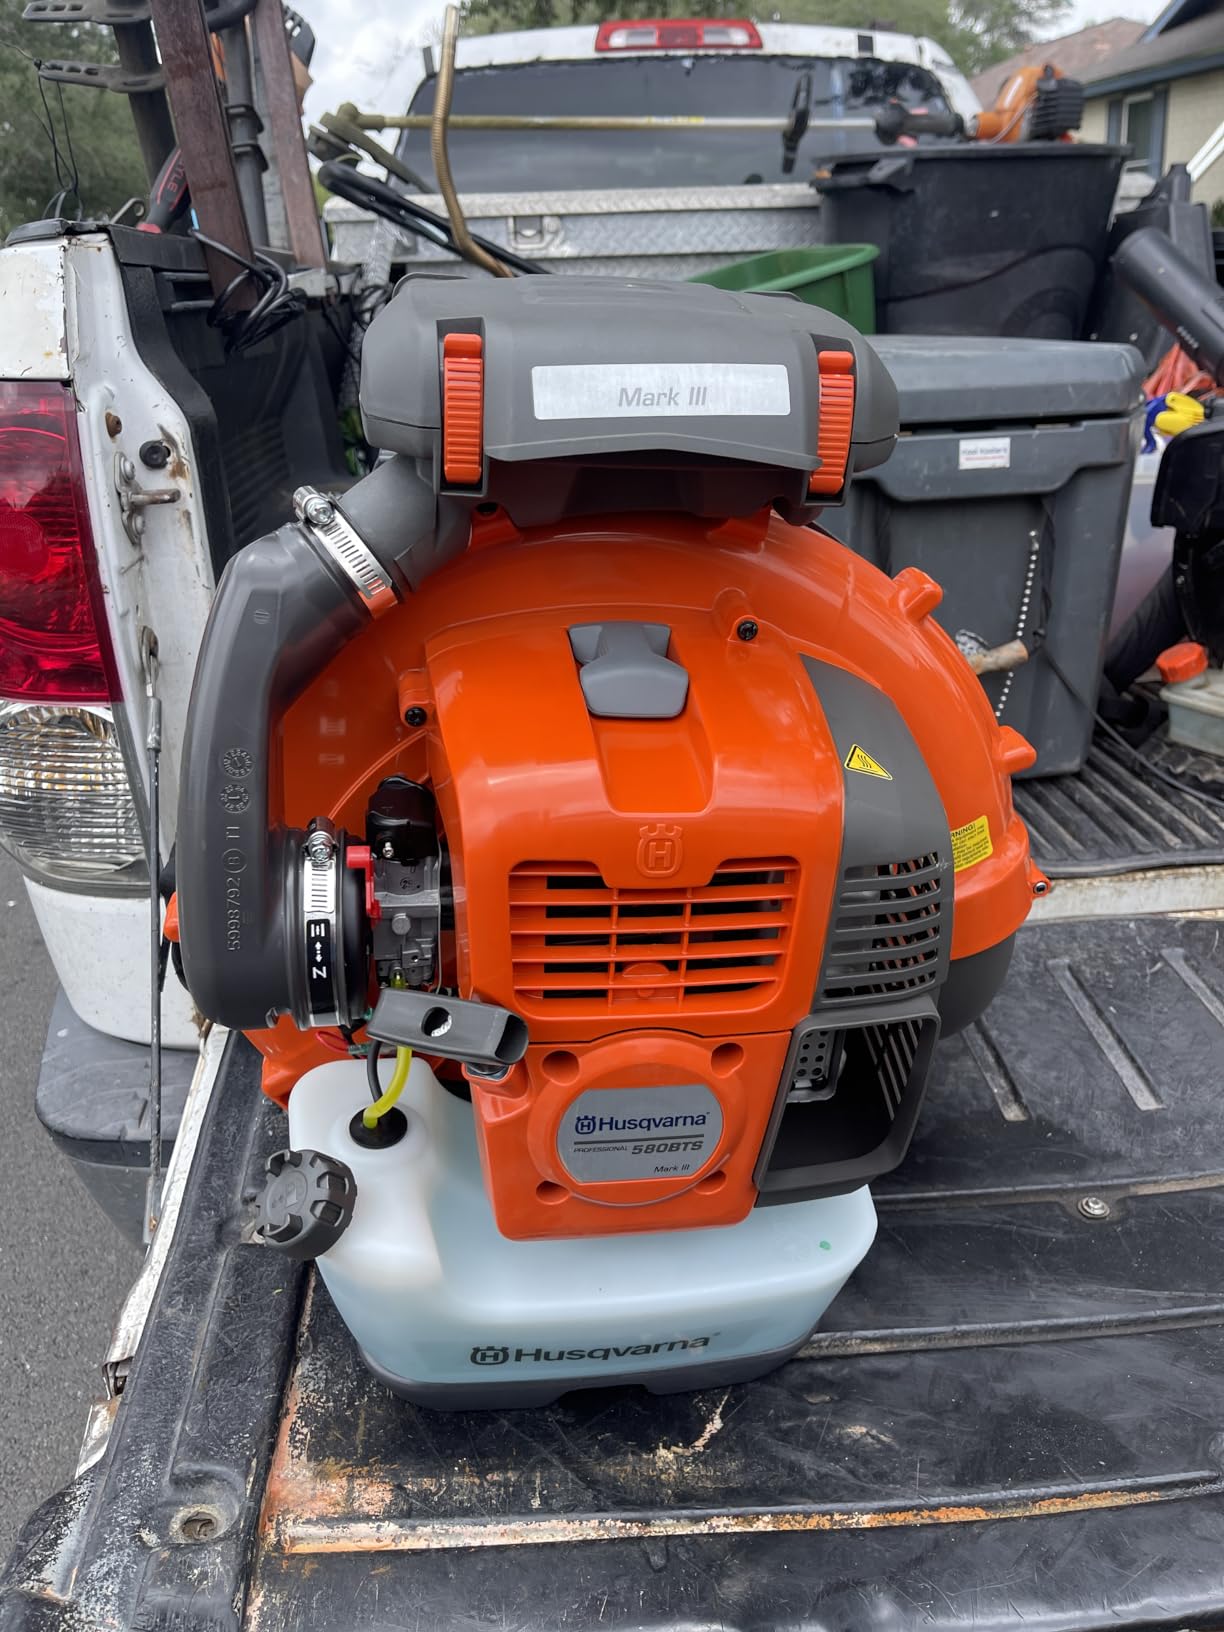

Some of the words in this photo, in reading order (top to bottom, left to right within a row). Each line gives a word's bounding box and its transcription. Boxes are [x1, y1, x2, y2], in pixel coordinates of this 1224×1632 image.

[618, 387, 680, 407] Mark
[688, 386, 708, 406] III
[599, 1114, 706, 1132] Husqvarna
[573, 1145, 628, 1153] PROFESSIONAL
[631, 1140, 704, 1155] 580BTS
[653, 1165, 678, 1174] Mark
[681, 1164, 690, 1172] III
[514, 1336, 711, 1362] Husqvarna
